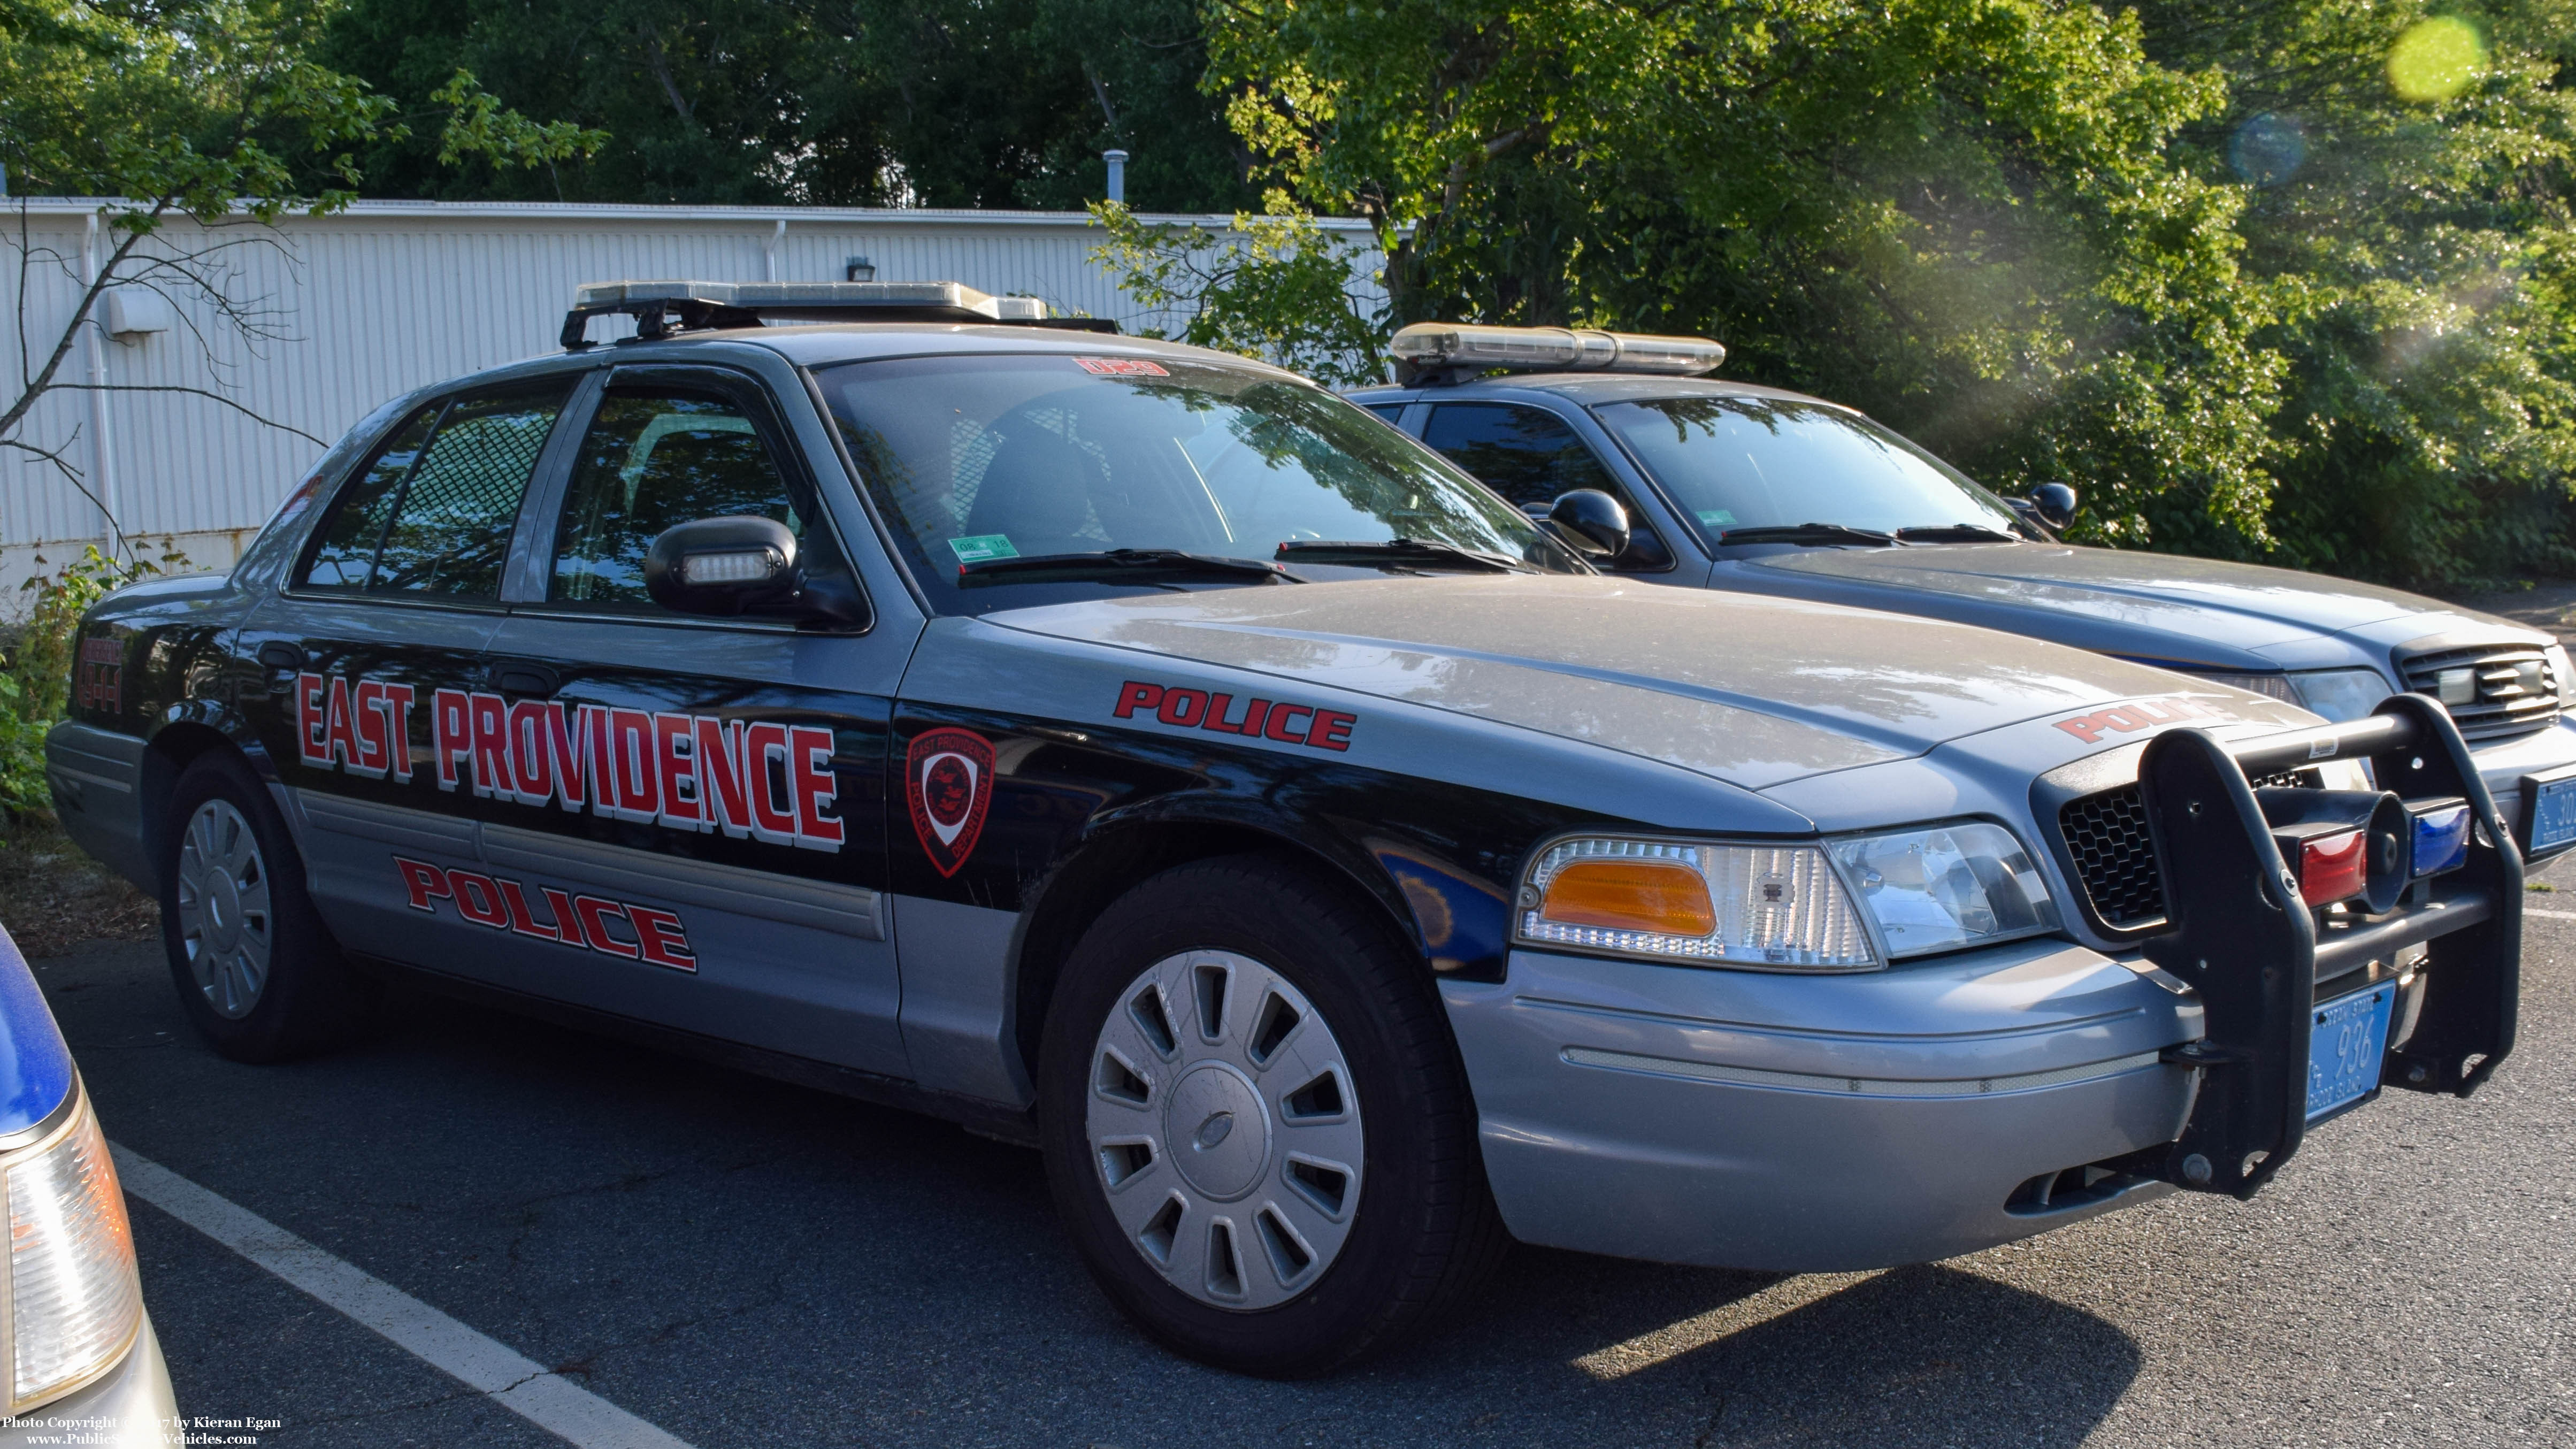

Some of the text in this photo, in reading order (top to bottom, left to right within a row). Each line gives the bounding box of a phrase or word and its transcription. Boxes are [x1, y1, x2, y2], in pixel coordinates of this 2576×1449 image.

[994, 540, 1009, 548] 18
[1113, 680, 1358, 752] POLICE
[2051, 697, 2241, 743] POLICE
[296, 672, 415, 785] EAST
[432, 688, 845, 853] PROVIDENCE
[913, 736, 990, 768] EAST PROVIDENCE
[911, 781, 934, 840] POLICE
[951, 772, 988, 858] DEPARTMENT
[392, 855, 697, 974] POLICE
[2335, 1014, 2374, 1079] 936
